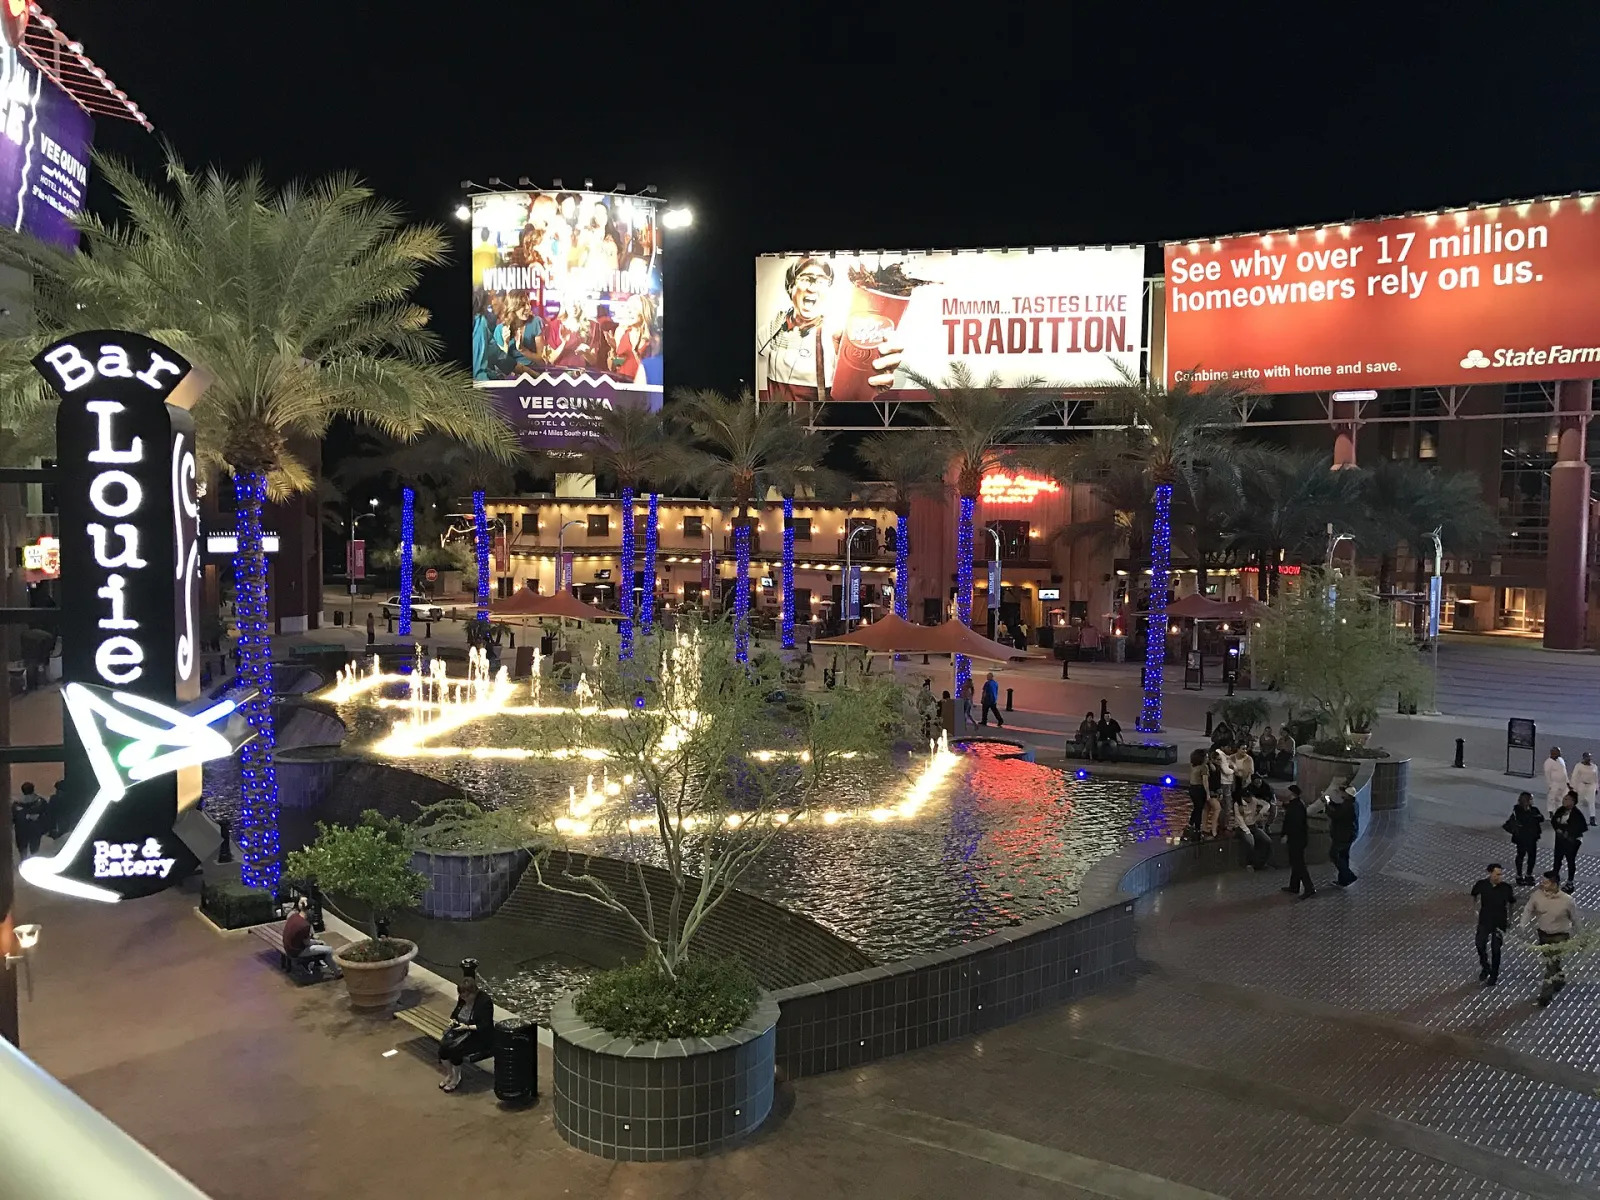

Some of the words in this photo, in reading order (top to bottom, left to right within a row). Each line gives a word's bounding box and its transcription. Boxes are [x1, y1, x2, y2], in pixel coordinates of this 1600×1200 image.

[40, 132, 61, 165] VEE
[60, 154, 87, 187] QUIVA
[40, 174, 58, 196] HOTEL
[1171, 257, 1222, 284] See
[1230, 249, 1287, 281] why
[1296, 245, 1363, 272] over
[1377, 232, 1416, 264] 17
[1429, 223, 1548, 259] million
[483, 266, 541, 291] WINNING
[1172, 277, 1356, 313] homeowners
[1367, 265, 1428, 300] rely
[1438, 265, 1480, 290] on
[1493, 260, 1543, 286] us.
[1085, 294, 1127, 312] LIKE
[942, 316, 1134, 355] TRADITION.
[44, 344, 181, 392] Bar
[1232, 367, 1261, 379] auto
[1264, 365, 1291, 378] with
[1294, 363, 1332, 377] home
[1336, 361, 1362, 374] and
[1366, 361, 1402, 374] save.
[519, 396, 554, 409] VEE
[86, 400, 147, 684] Louie
[93, 840, 138, 859] Bar
[141, 837, 163, 858] &
[93, 858, 176, 879] Eatery
